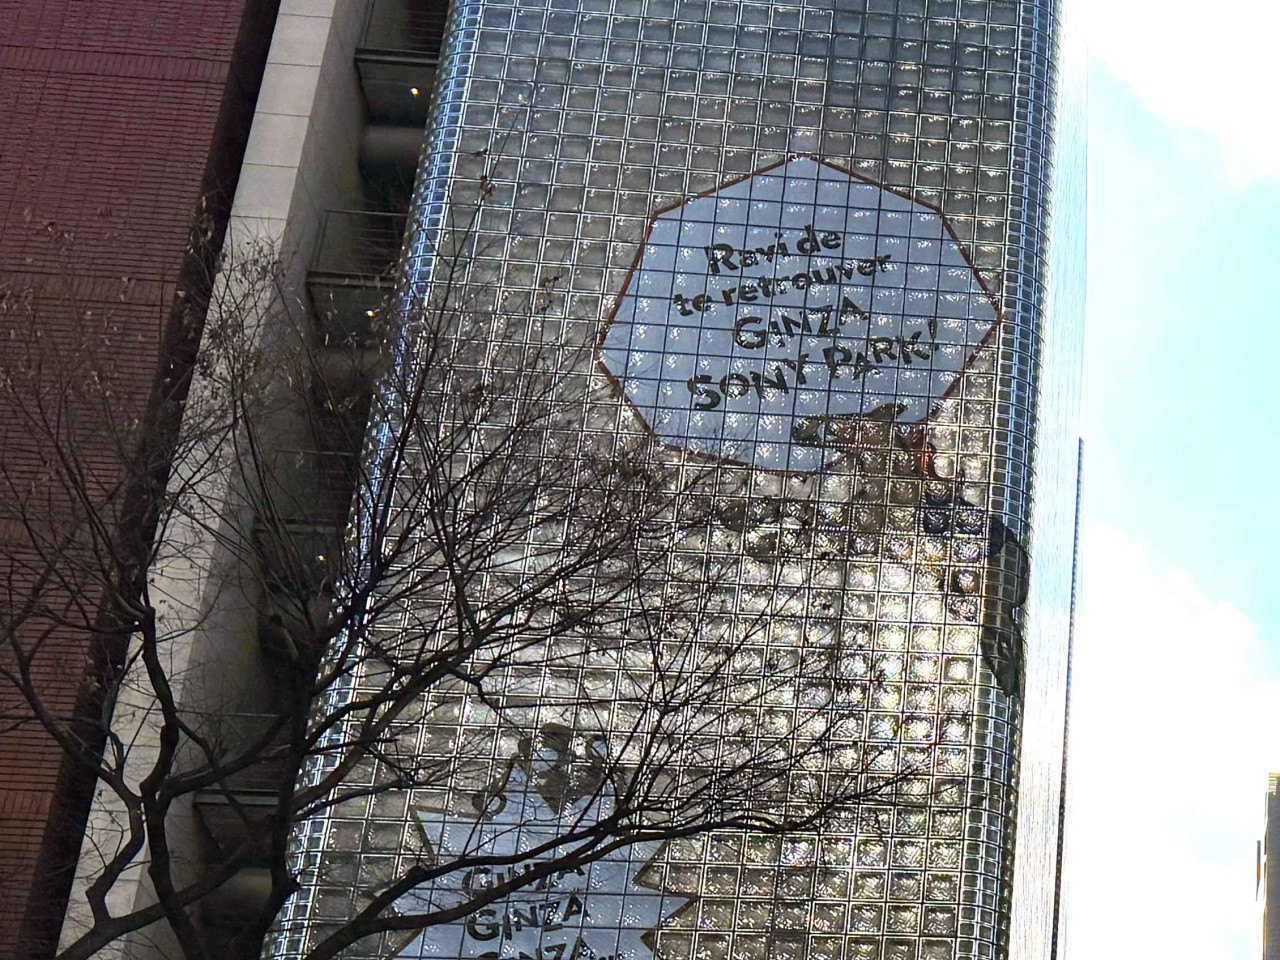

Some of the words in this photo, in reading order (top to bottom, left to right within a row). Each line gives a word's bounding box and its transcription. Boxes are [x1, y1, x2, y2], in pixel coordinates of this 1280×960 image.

[705, 231, 791, 274] Ravi
[797, 224, 842, 256] de
[673, 293, 713, 316] te
[722, 254, 892, 306] retrouver
[734, 296, 868, 349] GINZA
[687, 353, 810, 410] SONY
[823, 317, 940, 380] PARK!
[467, 892, 593, 941] GINZA
